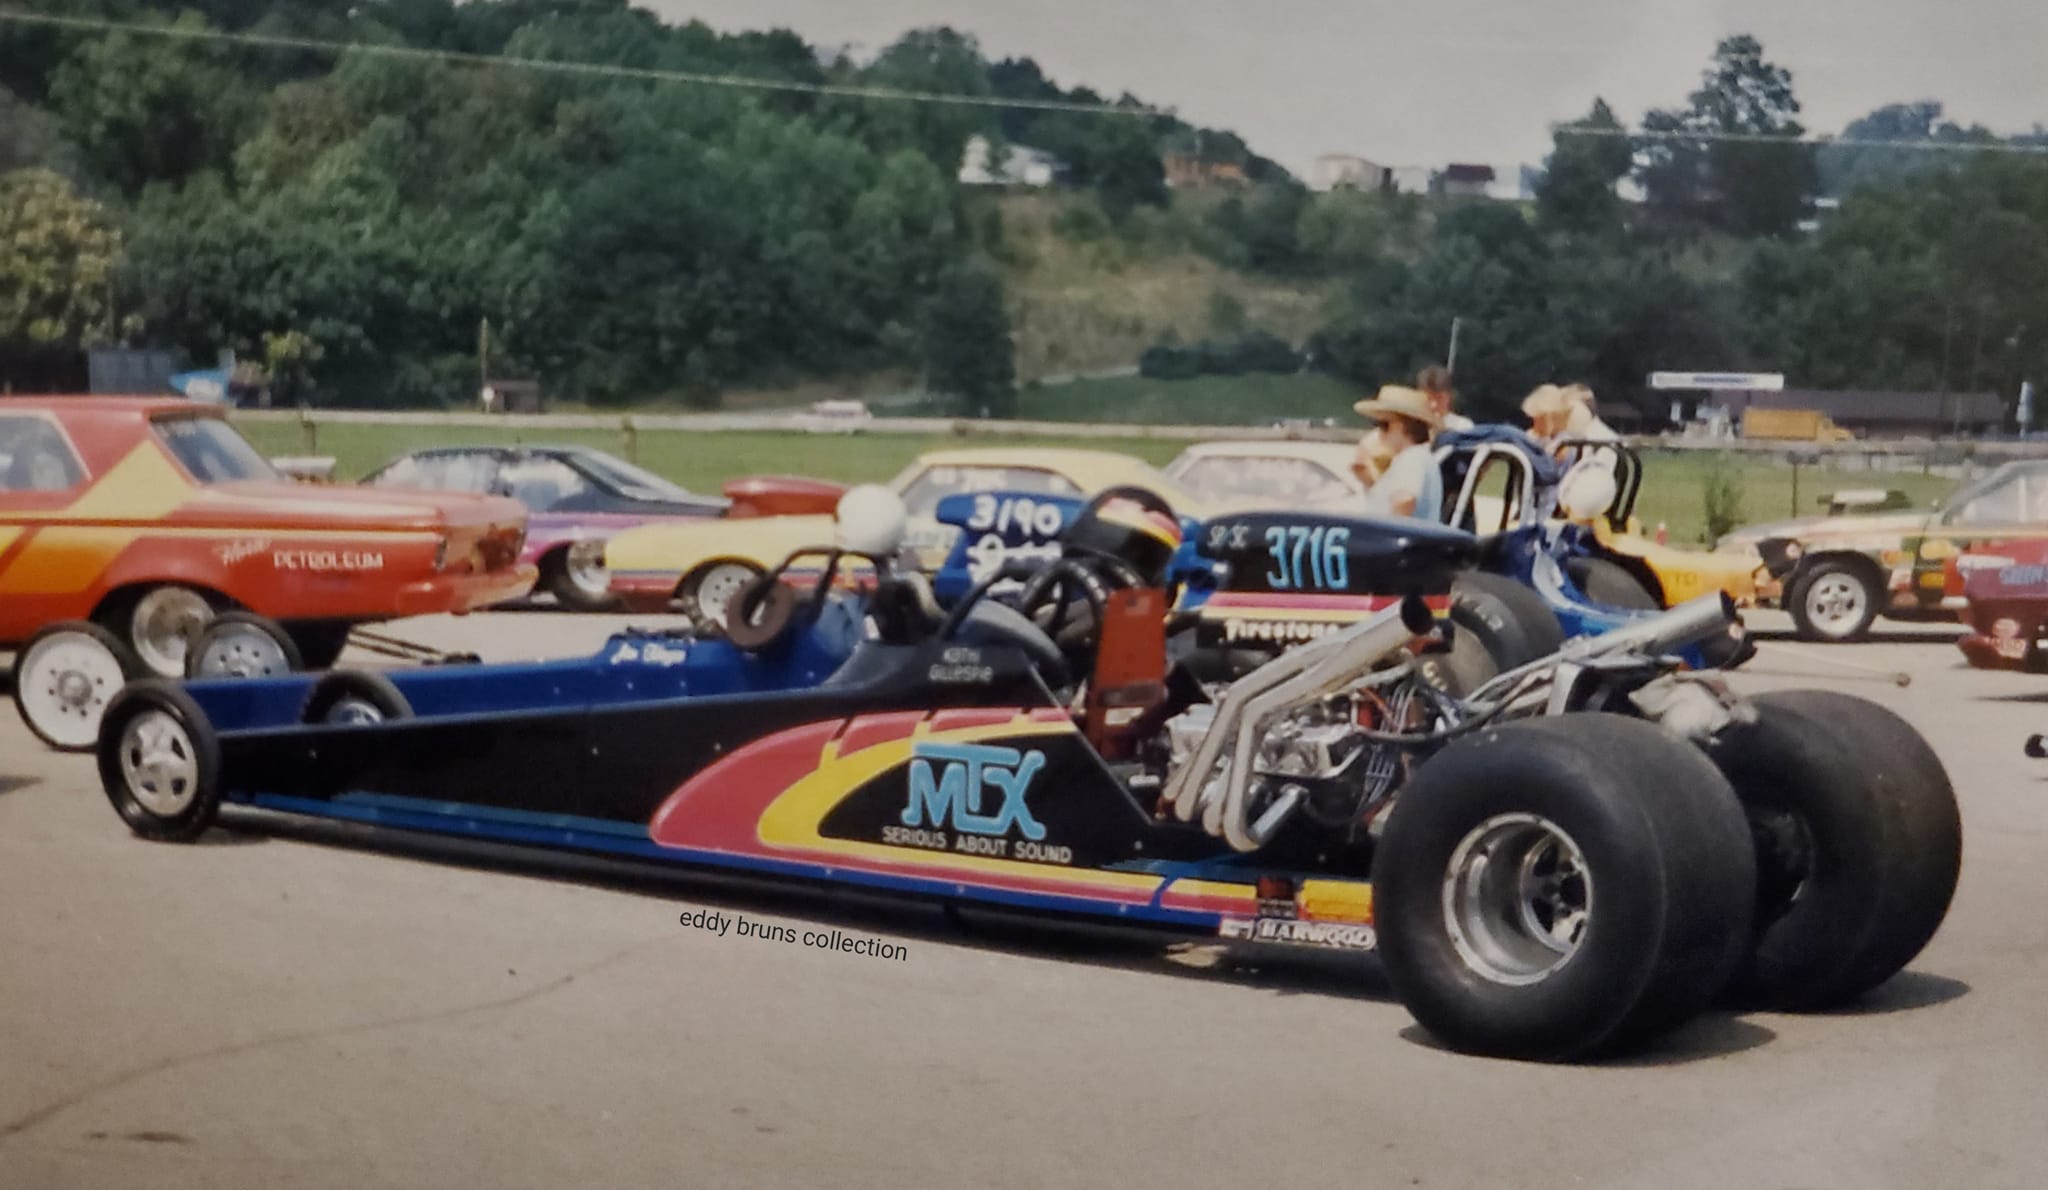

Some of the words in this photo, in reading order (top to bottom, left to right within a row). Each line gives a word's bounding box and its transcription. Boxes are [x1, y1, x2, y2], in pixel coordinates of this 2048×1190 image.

[1264, 525, 1350, 589] 3716
[1224, 619, 1339, 642] Firestone
[901, 742, 1047, 841] MTX
[882, 825, 947, 850] SERIOUS
[955, 835, 1008, 857] ABOUT
[1015, 841, 1072, 865] SOUND
[1260, 920, 1375, 949] HARWOOD
